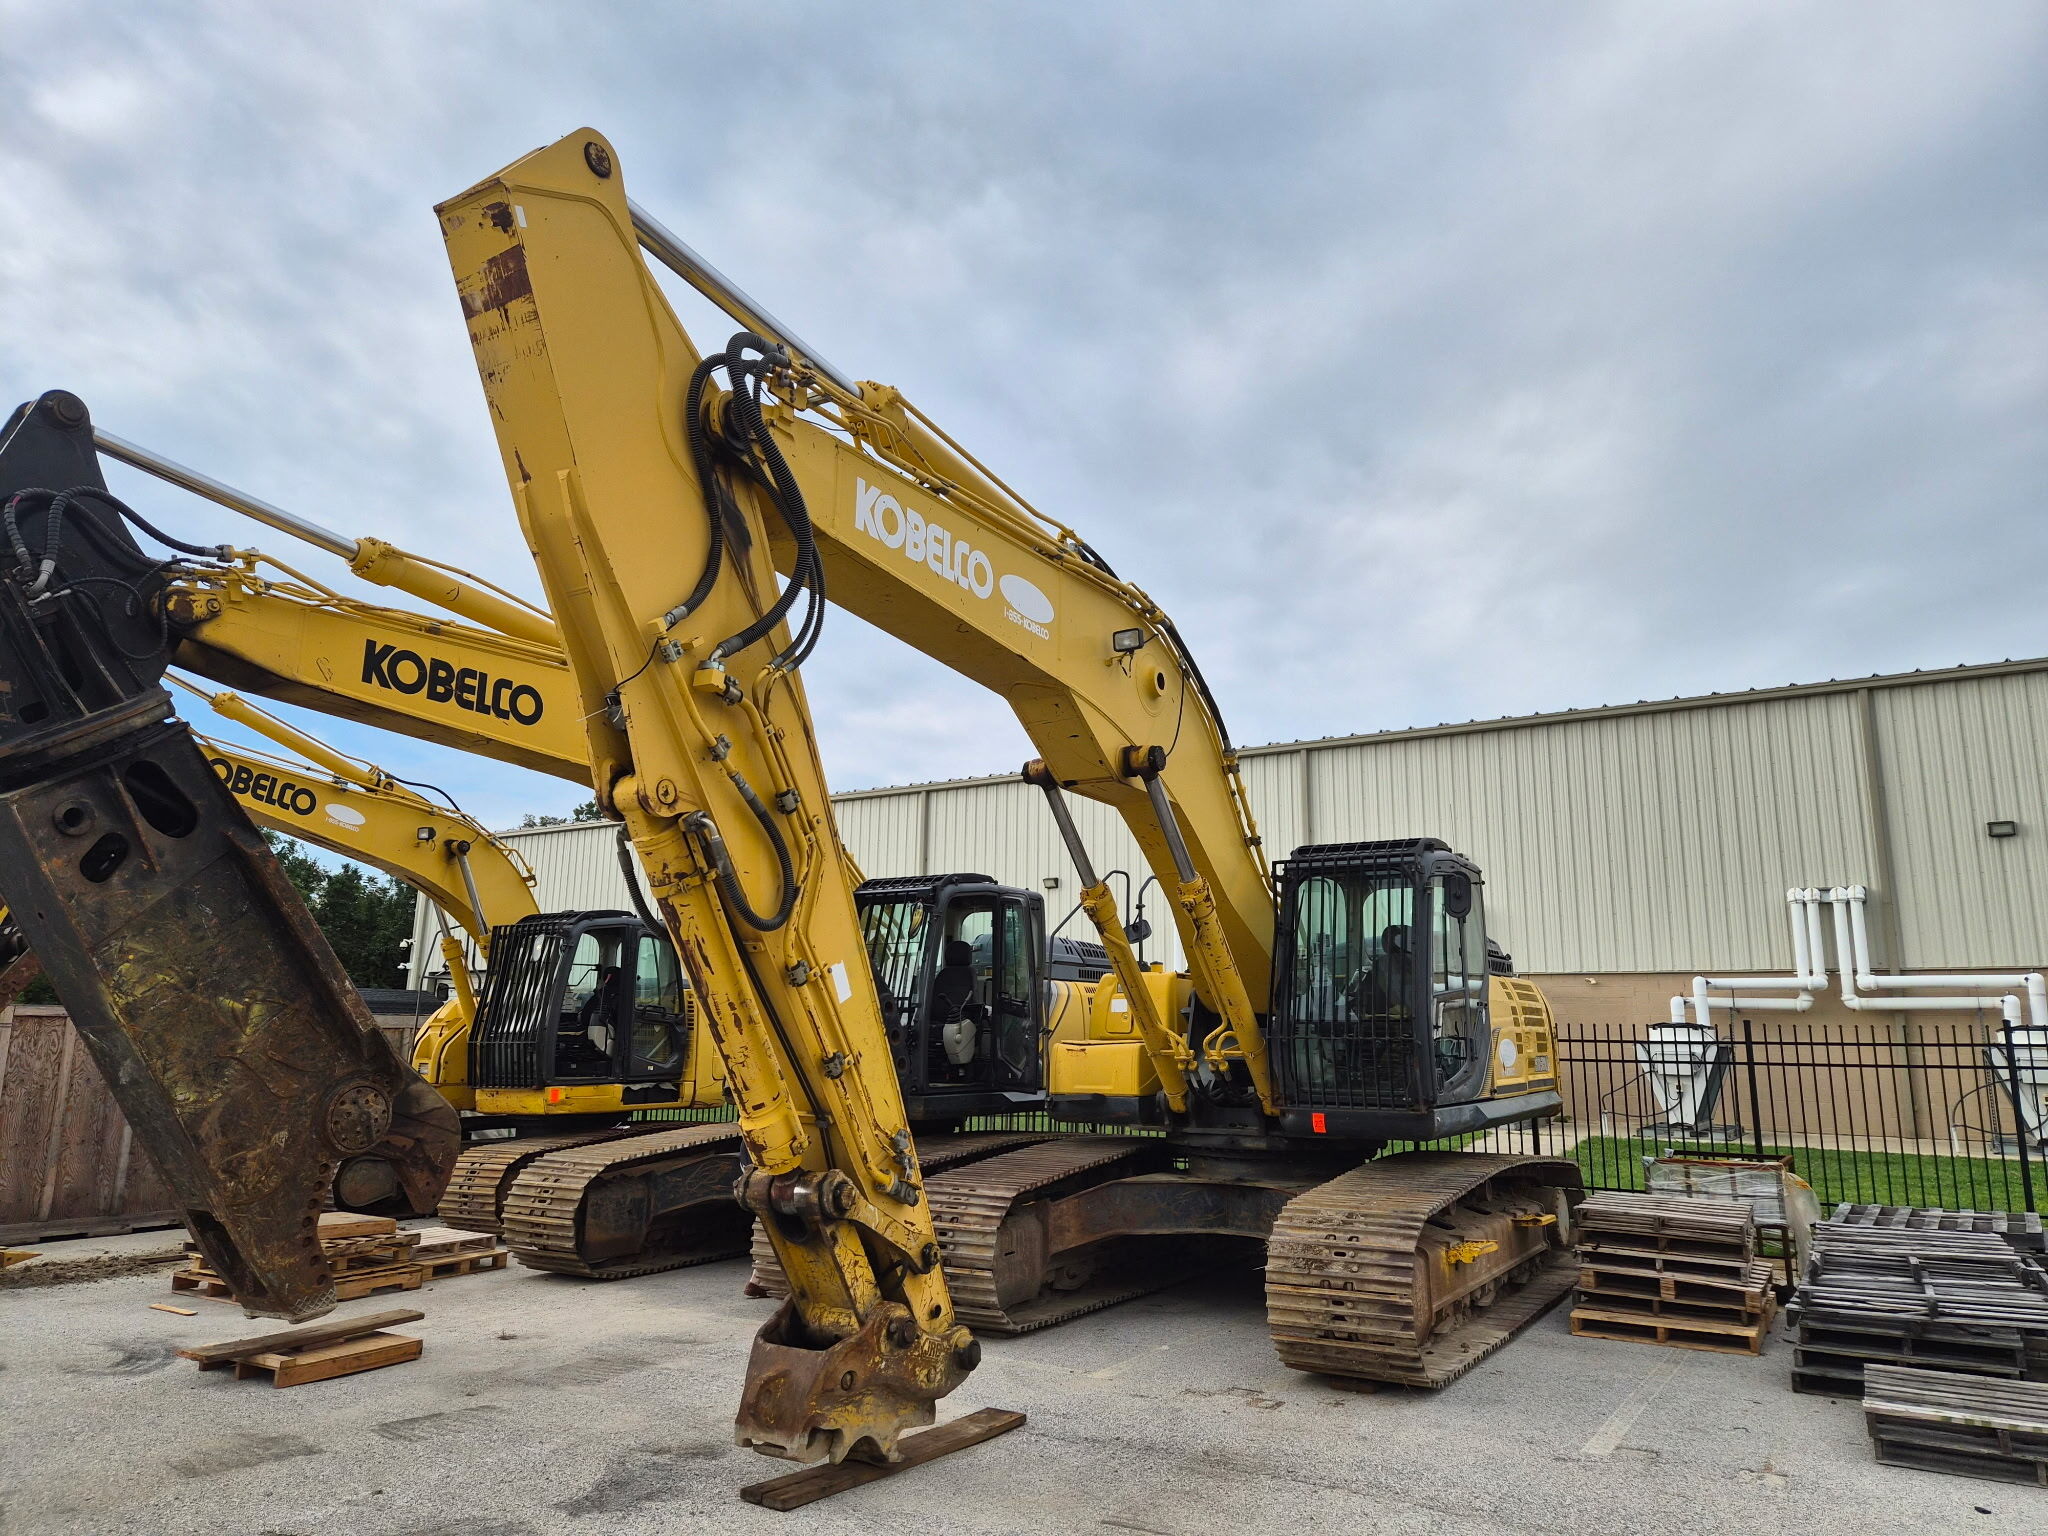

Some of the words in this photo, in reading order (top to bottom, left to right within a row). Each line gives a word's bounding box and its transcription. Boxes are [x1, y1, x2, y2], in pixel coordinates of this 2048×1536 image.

[855, 477, 993, 599] KOBELCO
[362, 639, 543, 726] KOBELCO
[209, 758, 317, 816] OBELCO
